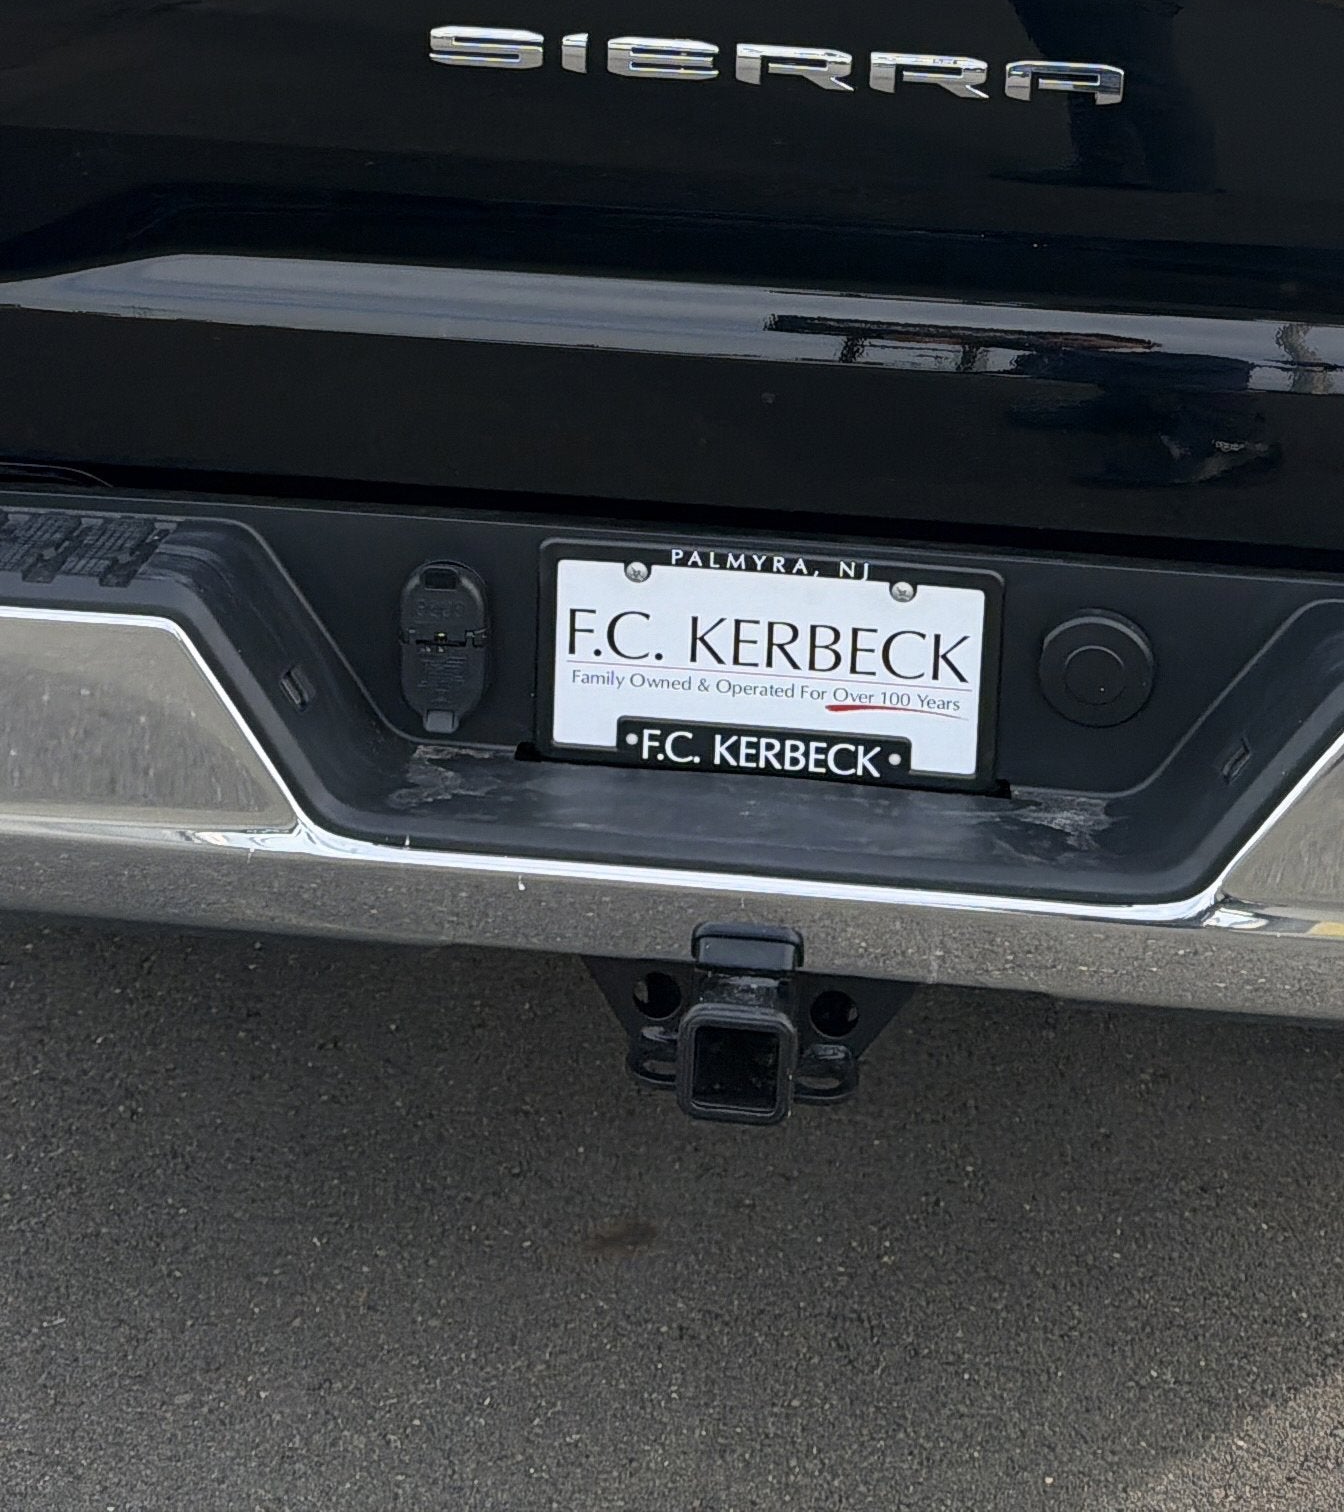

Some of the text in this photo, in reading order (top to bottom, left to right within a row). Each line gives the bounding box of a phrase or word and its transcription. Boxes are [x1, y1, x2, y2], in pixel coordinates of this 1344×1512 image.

[428, 24, 1126, 107] SIERRA
[671, 549, 871, 581] PALMYRA, NJ
[567, 607, 972, 683] F.C. KERBECK
[571, 669, 961, 711] Family Owned & Operated For Over 100 Years
[641, 729, 882, 778] F.C. KERBECK
